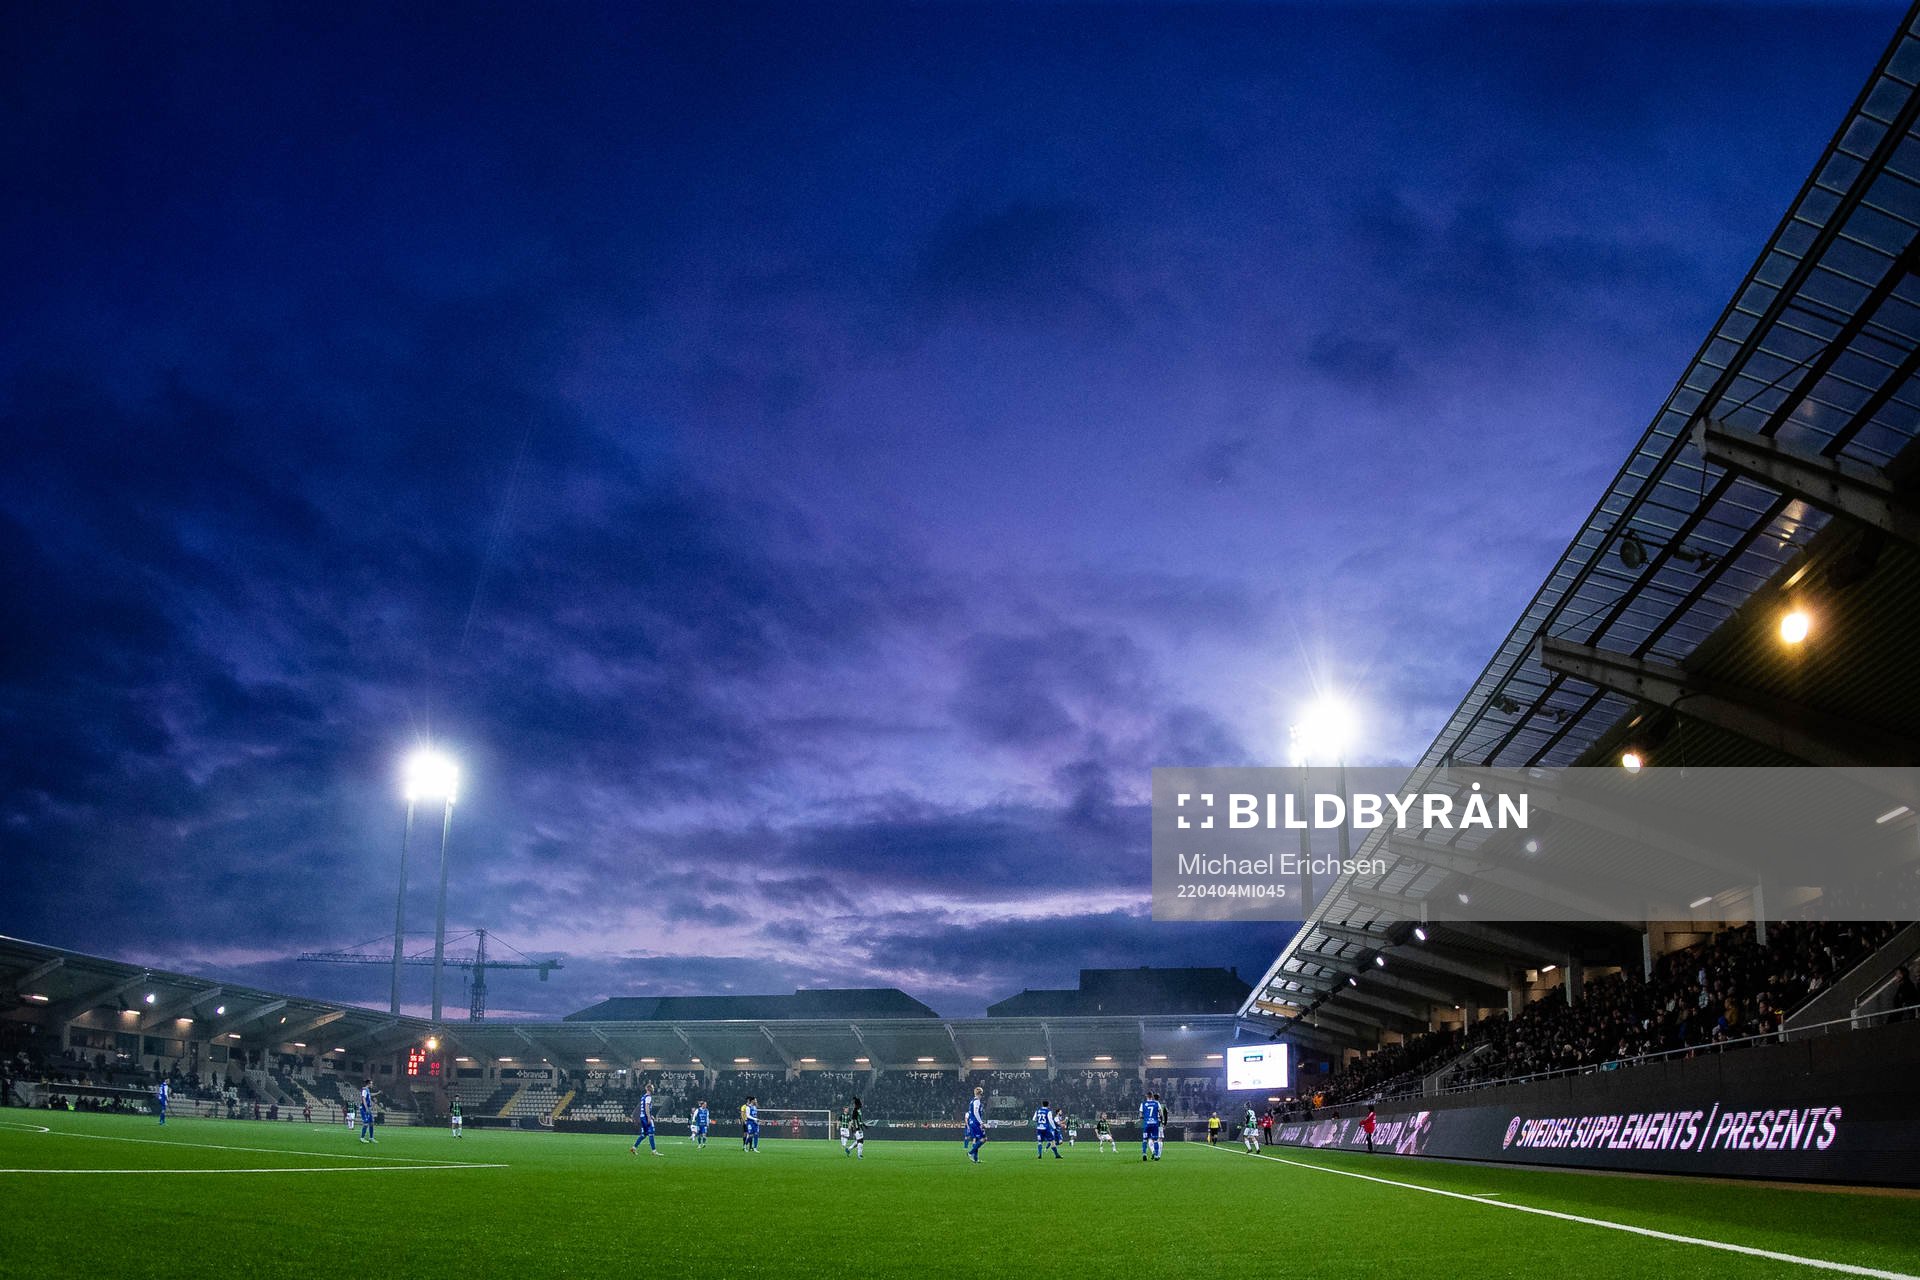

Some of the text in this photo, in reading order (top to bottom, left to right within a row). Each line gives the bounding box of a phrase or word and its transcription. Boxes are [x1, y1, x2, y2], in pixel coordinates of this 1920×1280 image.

[1148, 1106, 1154, 1117] 7
[1037, 1114, 1046, 1123] 23
[1516, 1106, 1842, 1150] SWEDISH SUPPLEMENTS PRESENTS
